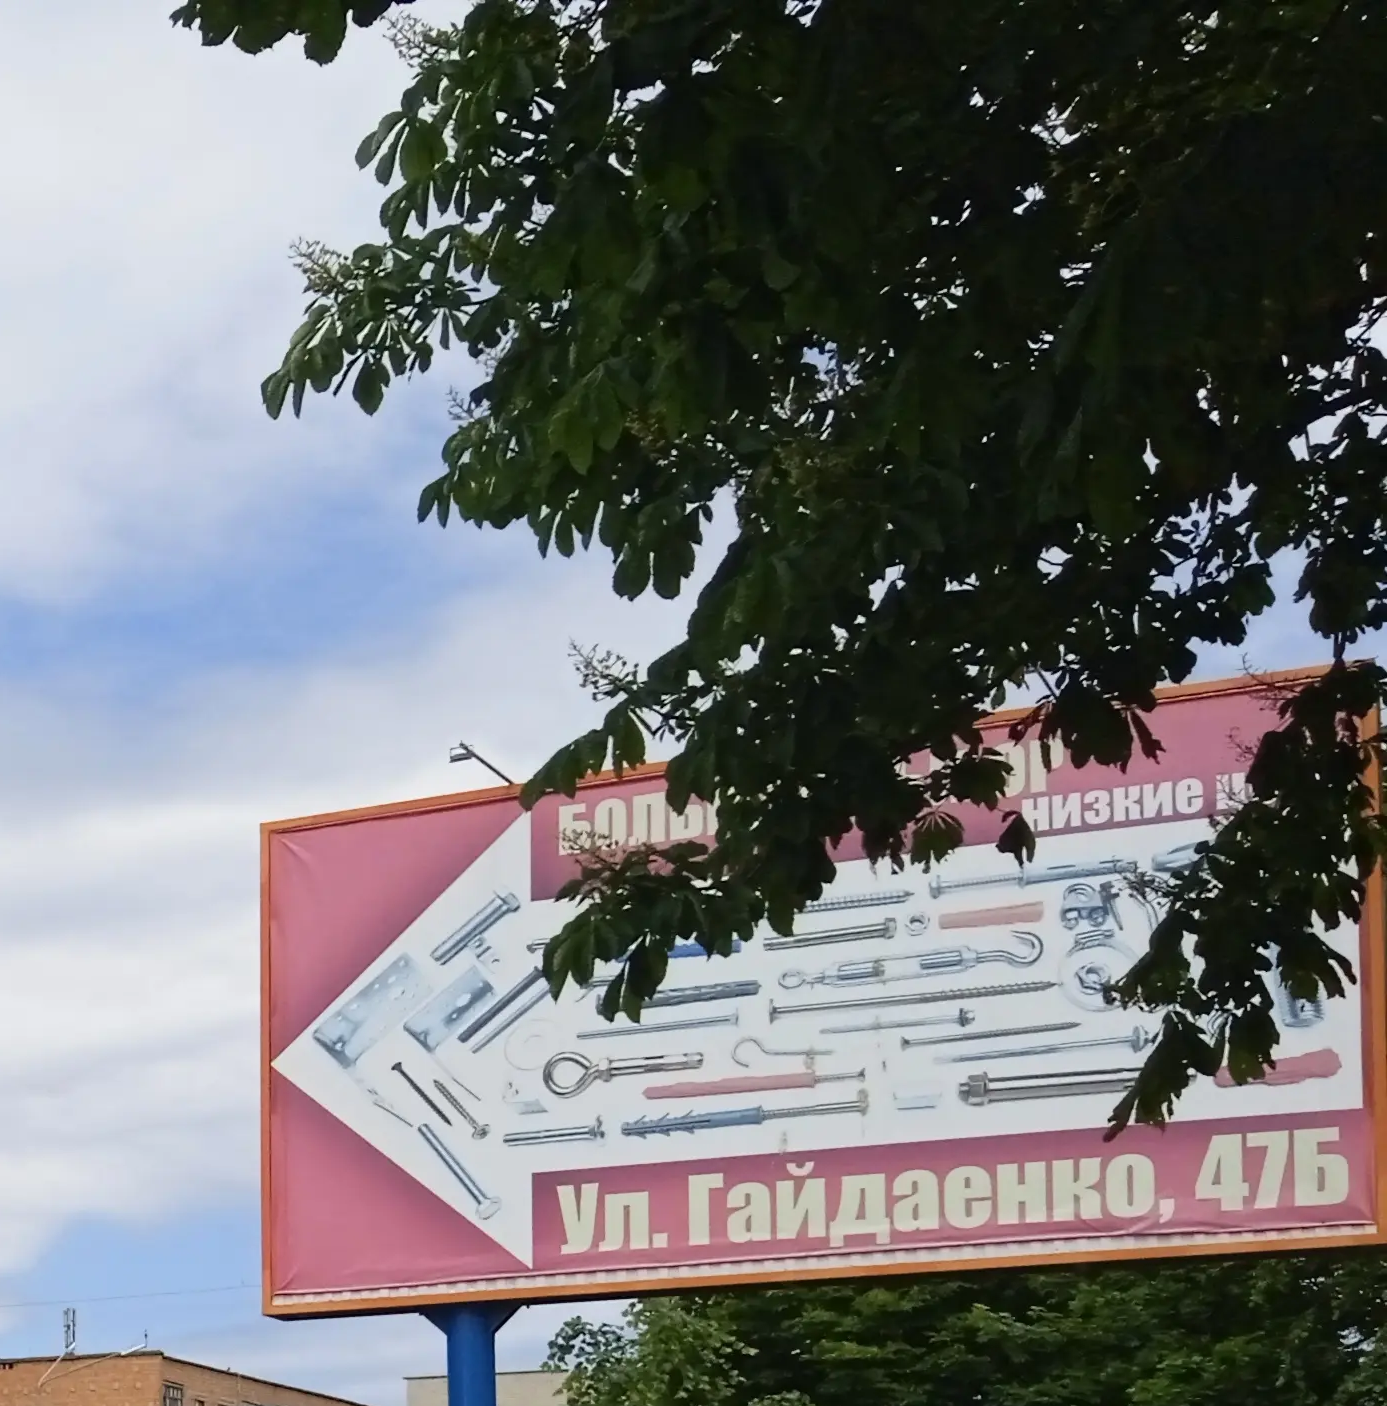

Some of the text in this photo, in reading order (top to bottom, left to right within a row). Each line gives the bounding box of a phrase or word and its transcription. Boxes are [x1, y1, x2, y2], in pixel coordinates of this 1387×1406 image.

[558, 787, 719, 856] БОЛЬ
[1022, 777, 1204, 833] низкие
[556, 1126, 1349, 1255] Ул. Гайдаенко, 47Б
